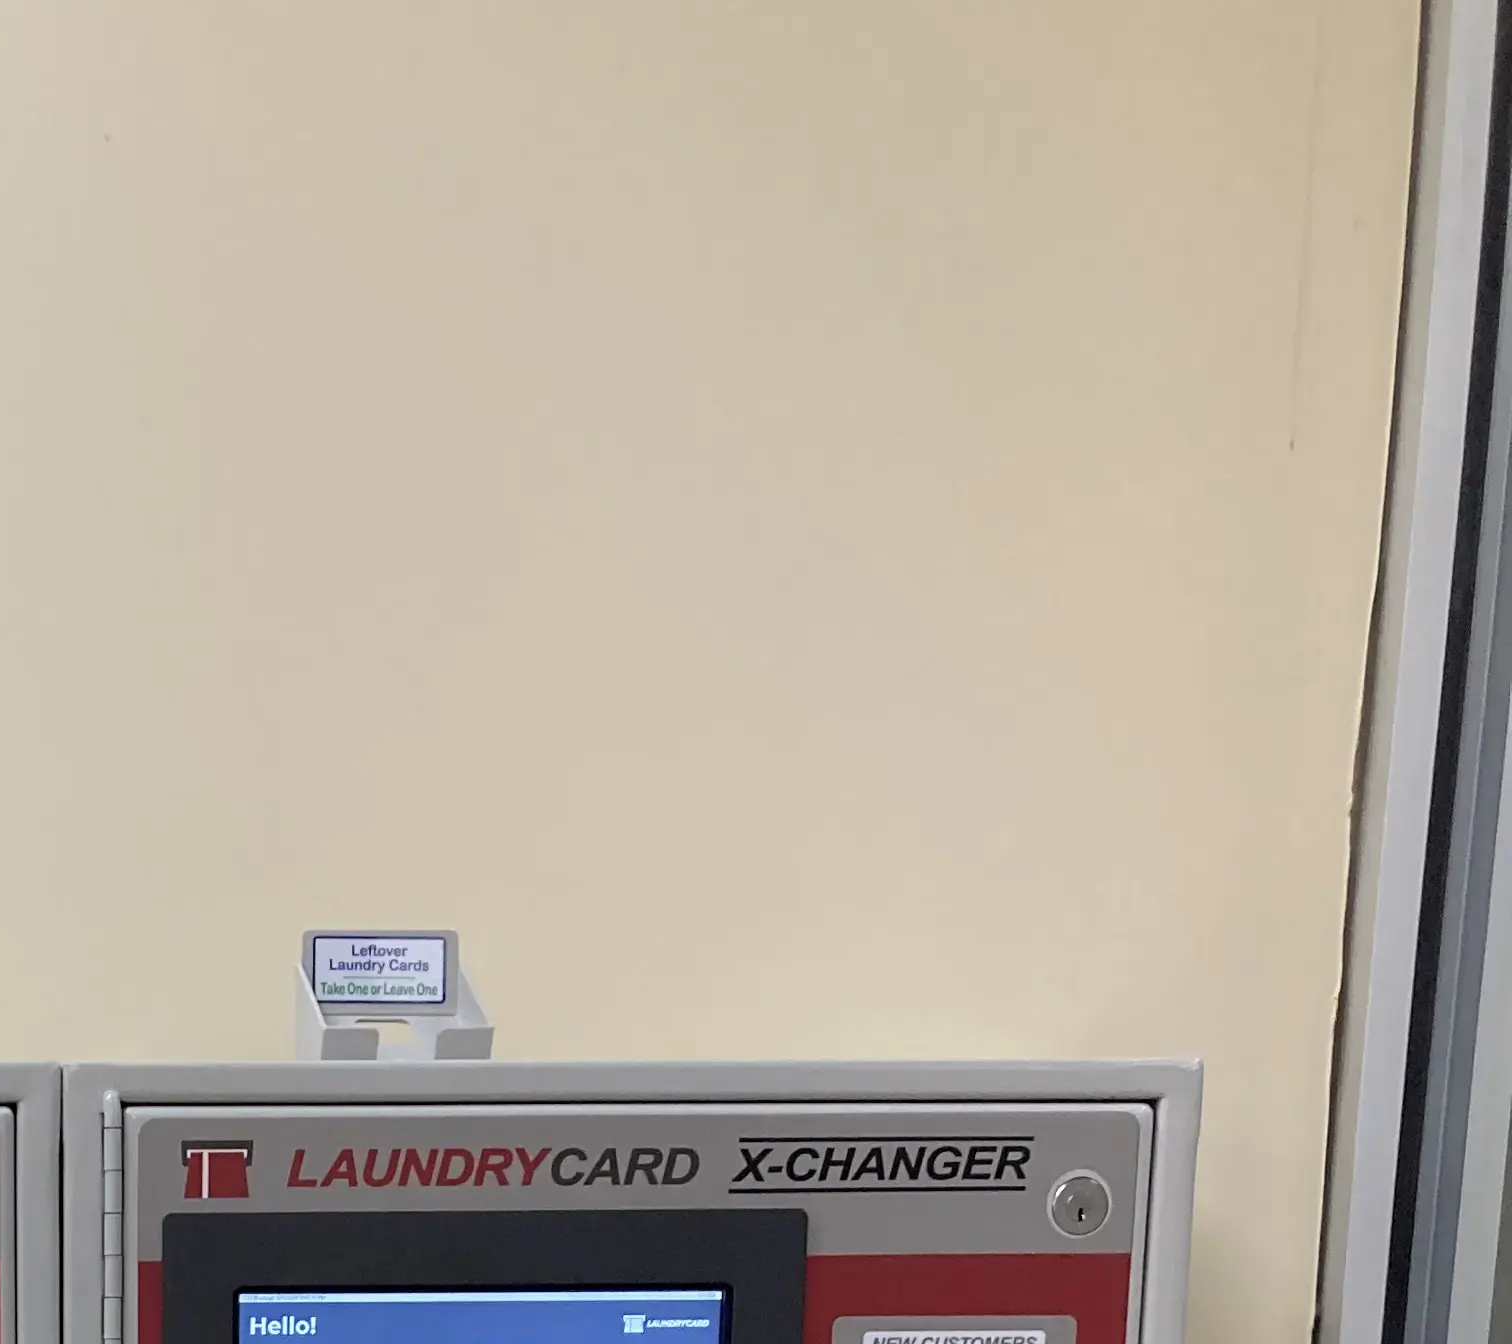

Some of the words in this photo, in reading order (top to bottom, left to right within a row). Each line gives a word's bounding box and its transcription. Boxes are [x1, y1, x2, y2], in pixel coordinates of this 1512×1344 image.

[351, 944, 408, 957] Leftover
[329, 959, 385, 974] Laundry
[389, 959, 429, 972] Cards
[320, 982, 345, 996] Take
[347, 982, 369, 996] One
[370, 985, 382, 996] or
[383, 982, 415, 996] Leave
[417, 983, 438, 996] One
[287, 1148, 700, 1187] LAUNDRYCARD
[732, 1145, 1031, 1182] X-CHANGER
[249, 1316, 317, 1336] Hello!
